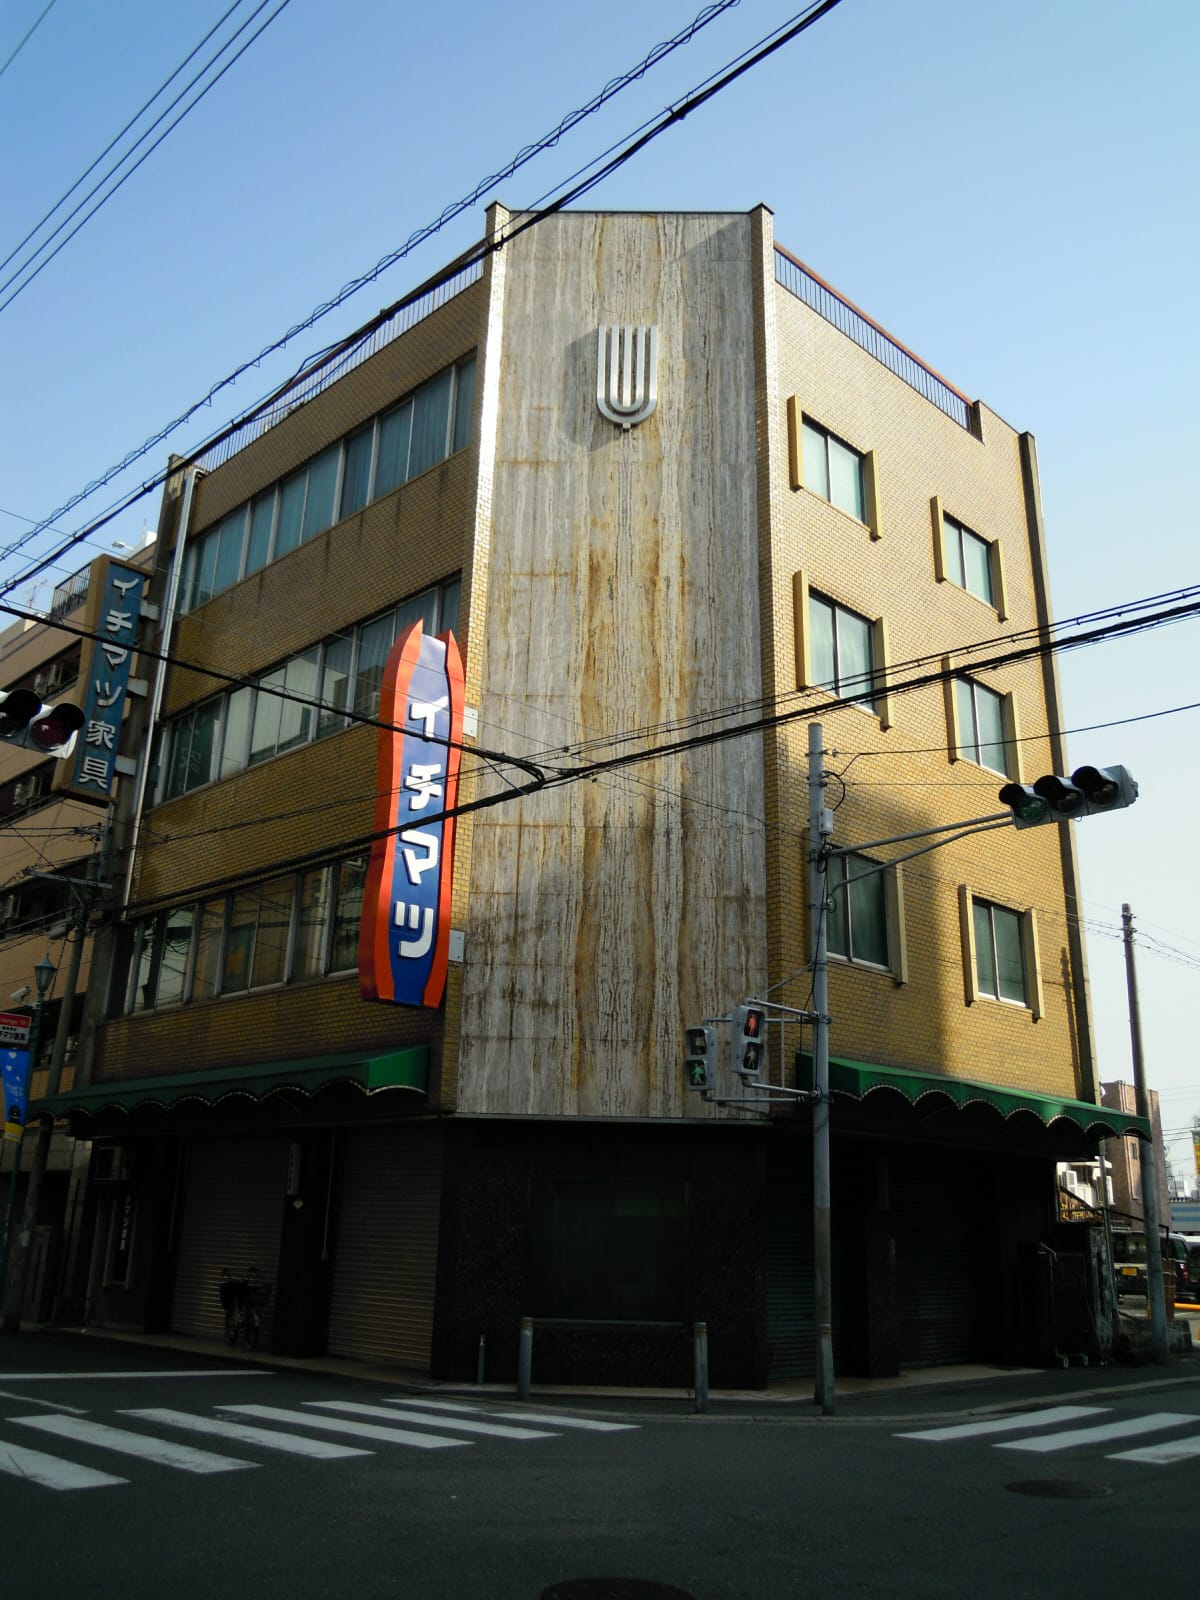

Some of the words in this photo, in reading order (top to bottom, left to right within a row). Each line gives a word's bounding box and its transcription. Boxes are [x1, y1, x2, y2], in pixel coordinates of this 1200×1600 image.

[79, 577, 140, 788] イチマツ家具
[394, 696, 448, 959] イチマツ
